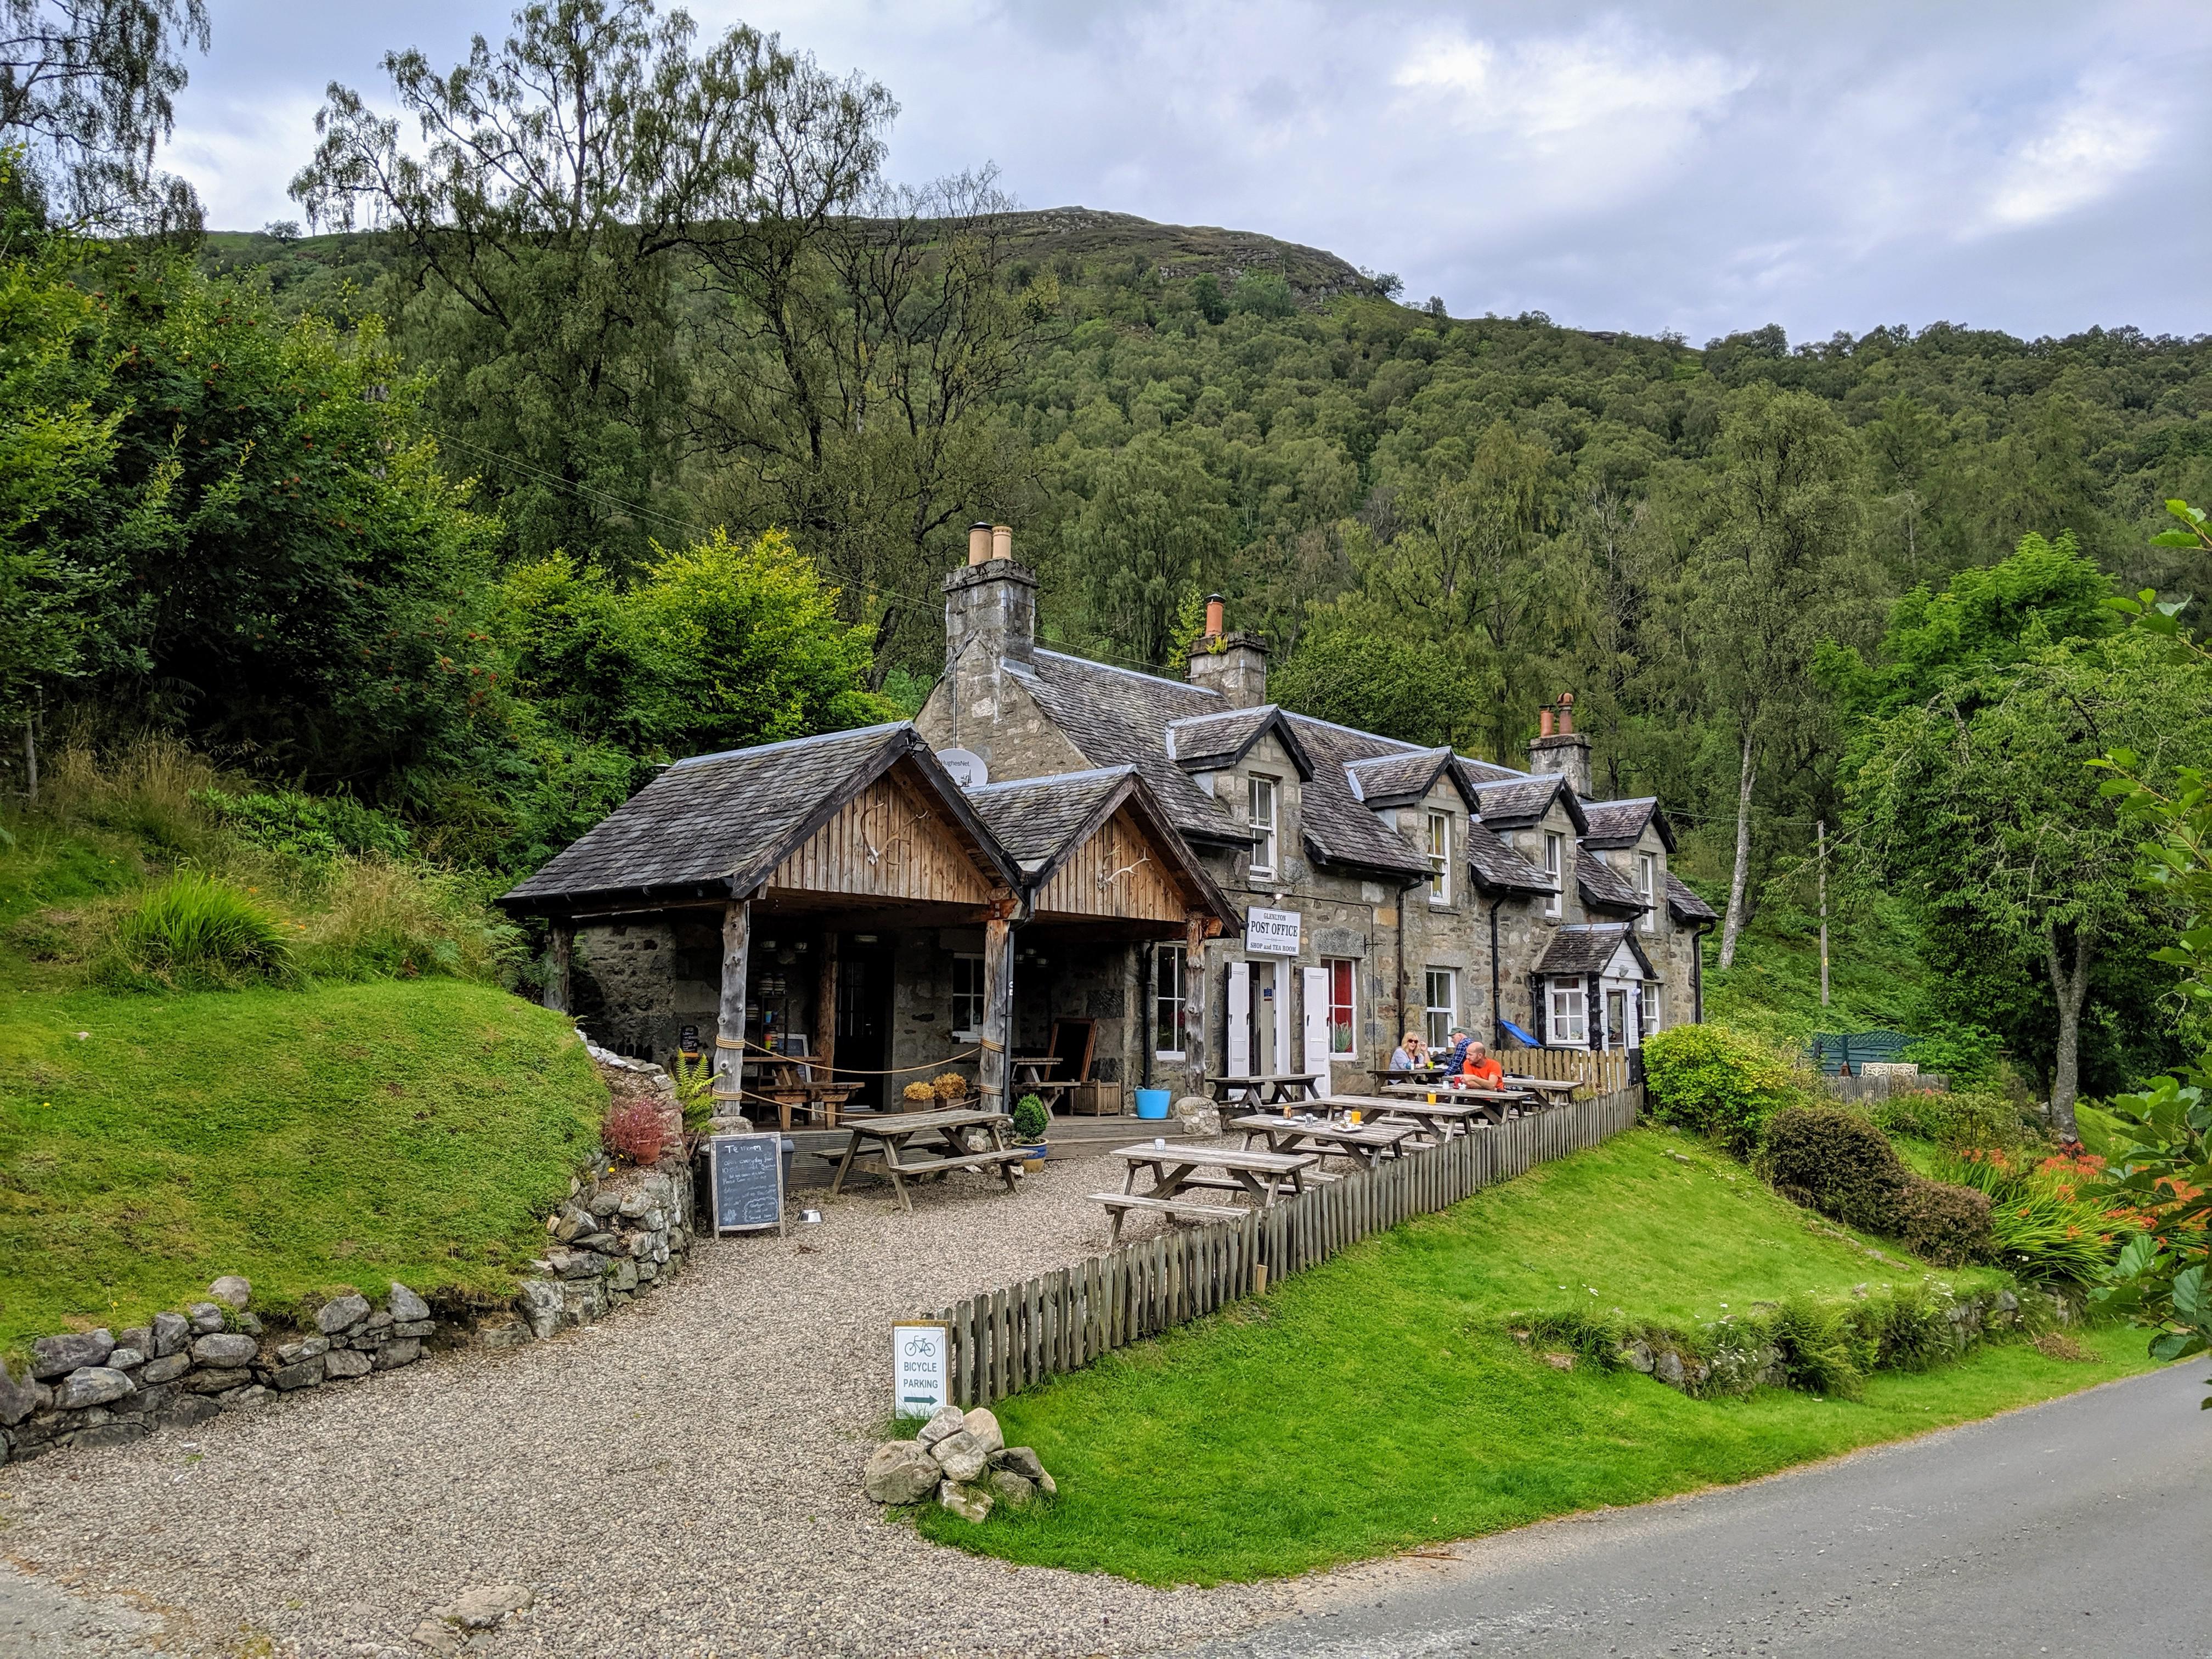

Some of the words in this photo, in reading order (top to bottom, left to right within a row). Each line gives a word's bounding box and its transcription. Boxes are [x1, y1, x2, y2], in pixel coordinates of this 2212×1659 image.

[1251, 921, 1269, 934] POST
[1272, 923, 1297, 936] OFFICE
[904, 1362, 937, 1372] BICYCLE
[903, 1379, 938, 1389] PARKING
